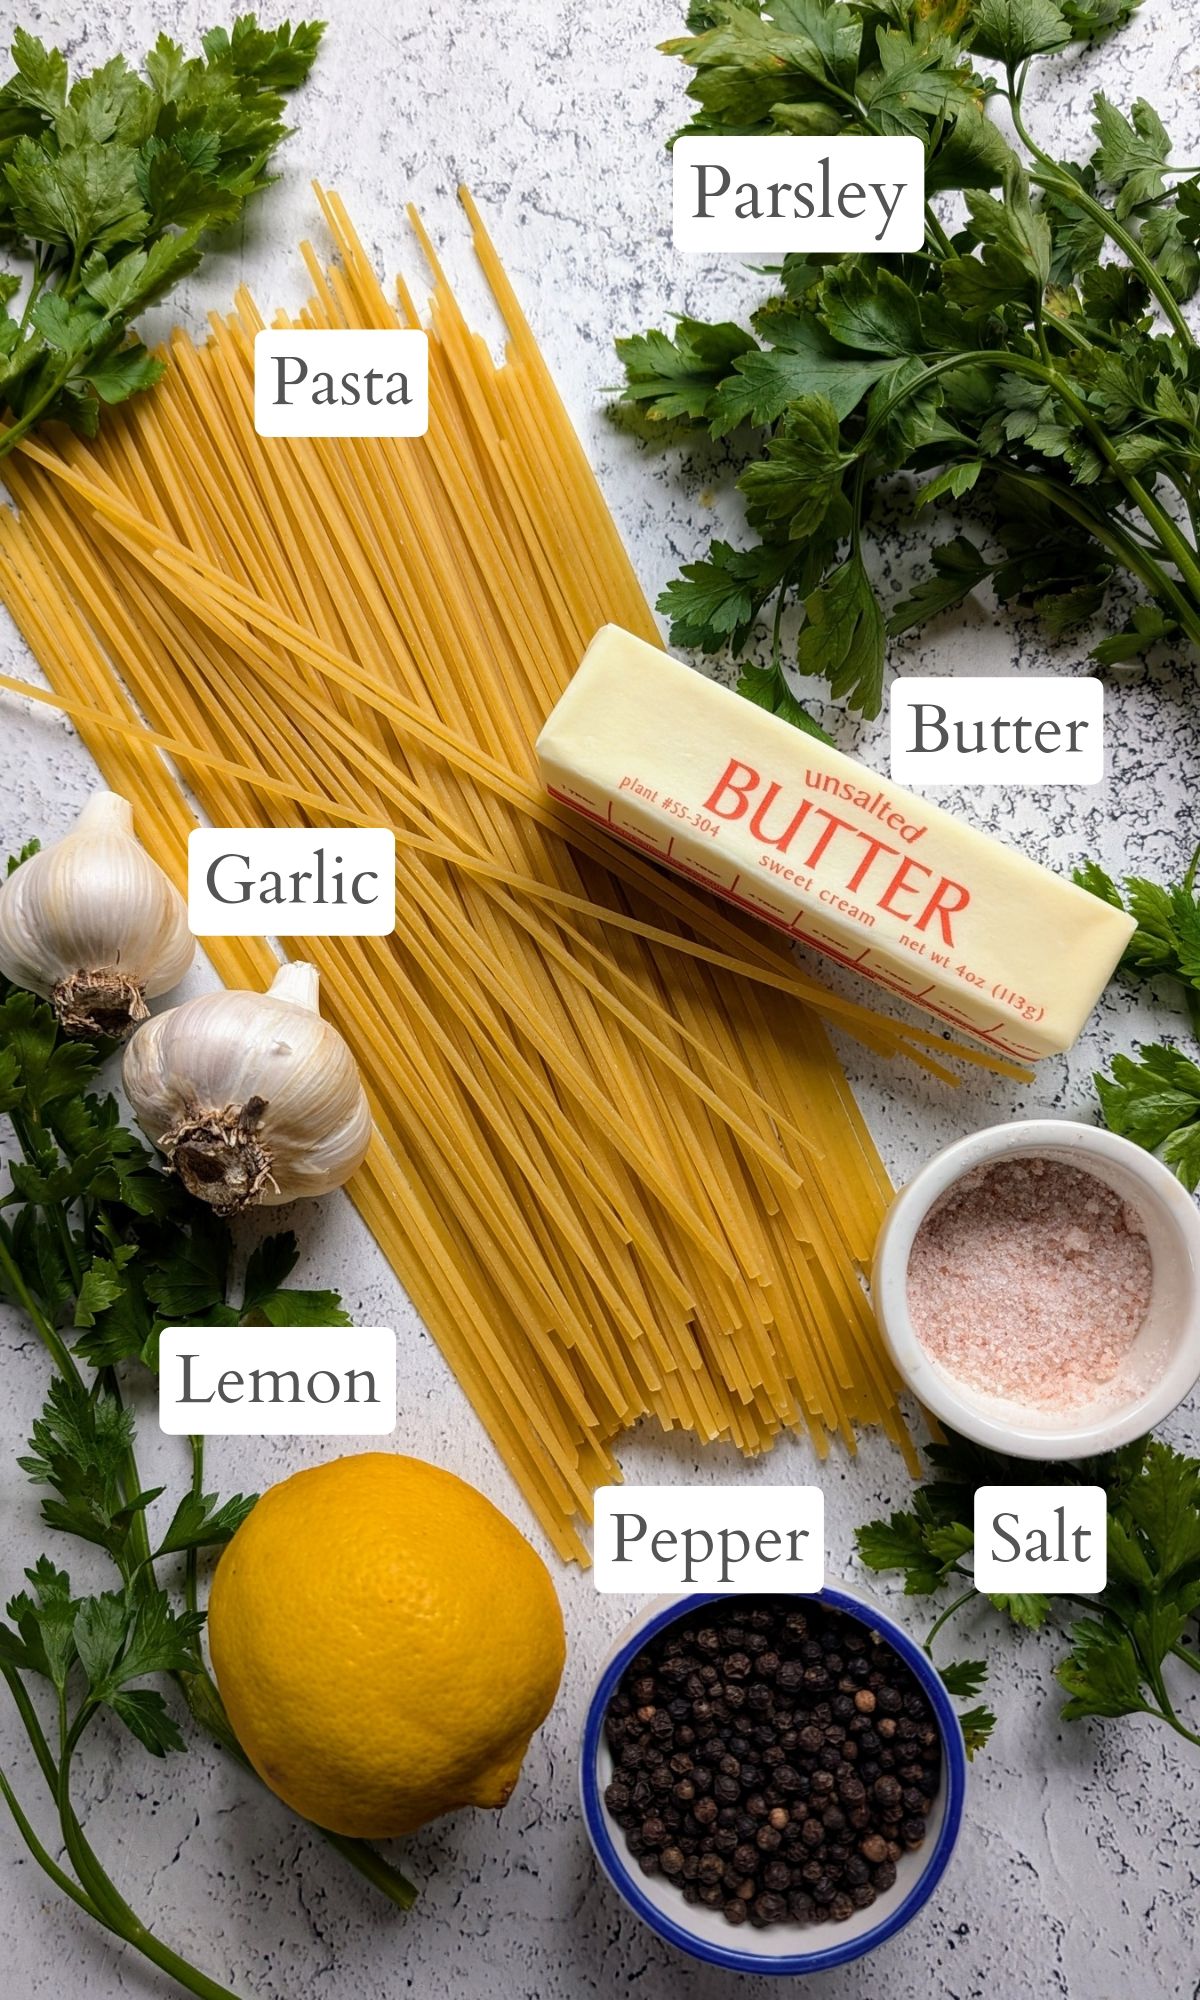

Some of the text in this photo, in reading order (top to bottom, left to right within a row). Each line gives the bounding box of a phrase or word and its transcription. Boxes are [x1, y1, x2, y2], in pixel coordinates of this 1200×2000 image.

[618, 776, 659, 803] plant
[661, 797, 721, 838] #55-304
[804, 769, 928, 844] unsalted
[702, 758, 971, 948] BUTTER
[758, 855, 815, 892] sweet
[819, 889, 876, 927] cream
[898, 934, 927, 955] net
[930, 951, 951, 968] wt
[955, 965, 986, 989] 4oz
[992, 984, 1045, 1022] (113g)
